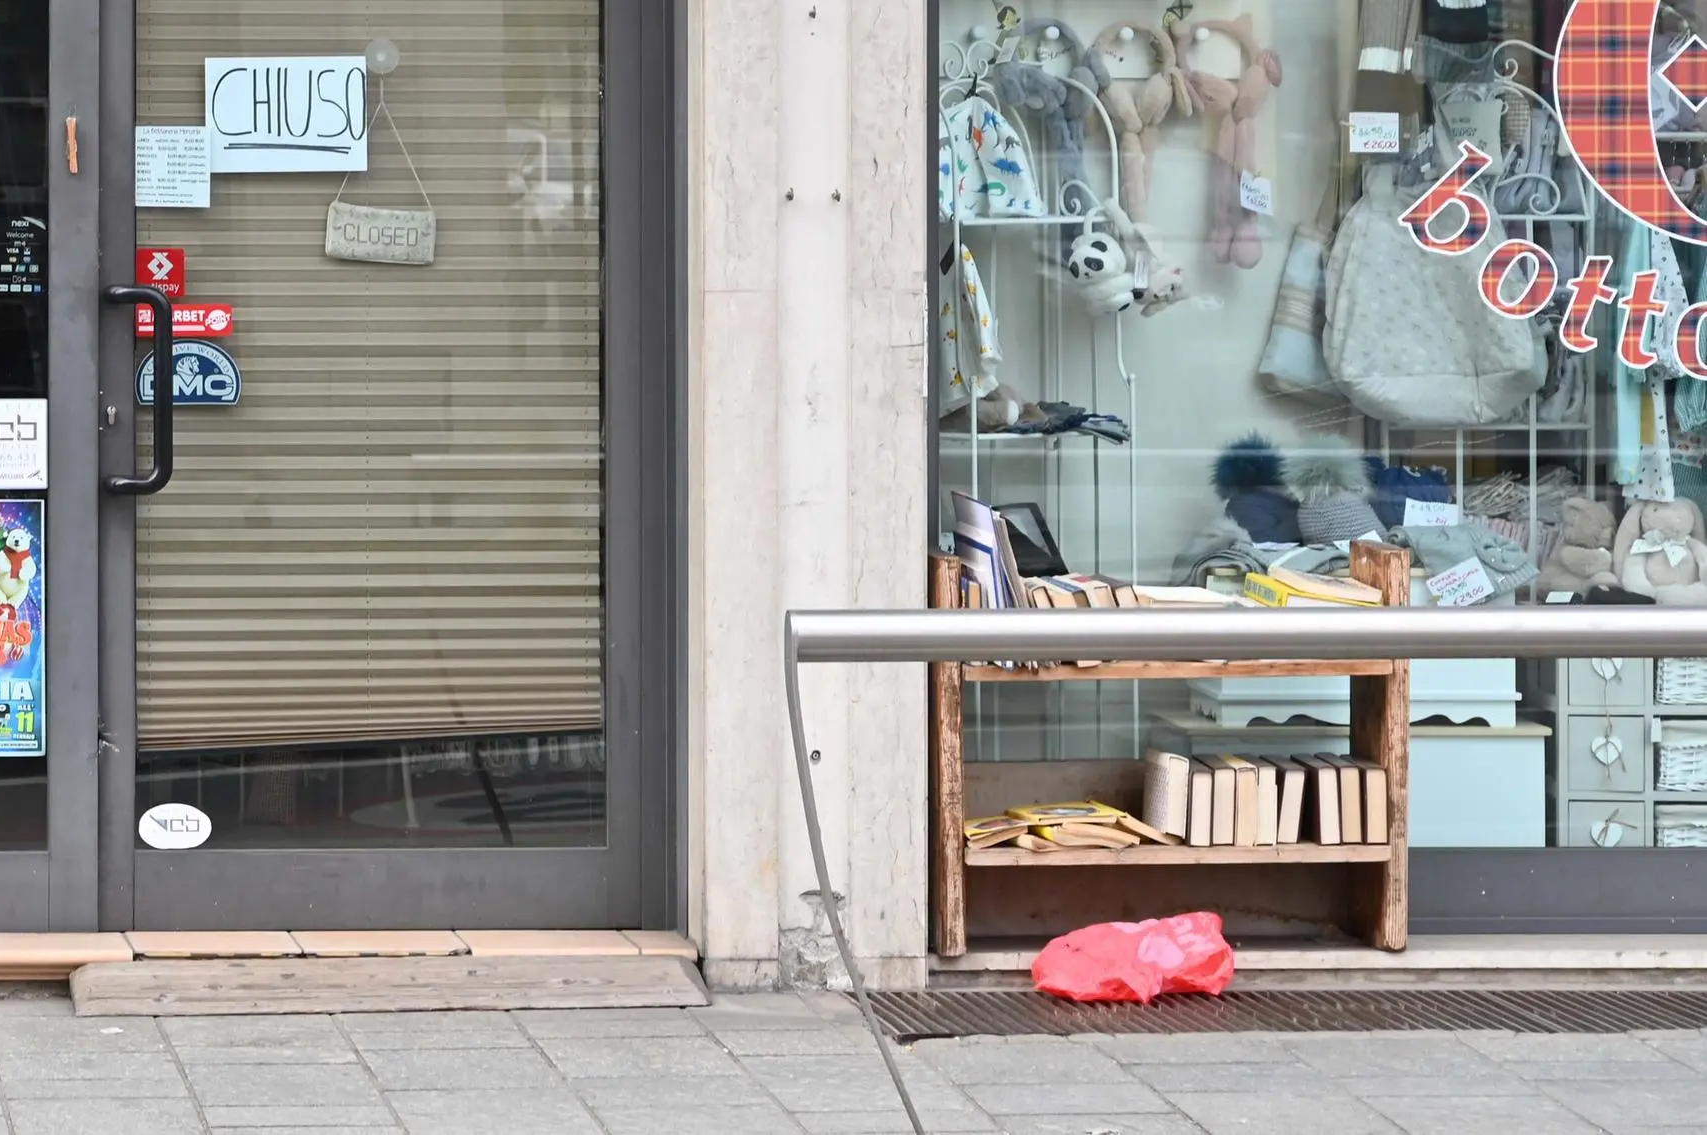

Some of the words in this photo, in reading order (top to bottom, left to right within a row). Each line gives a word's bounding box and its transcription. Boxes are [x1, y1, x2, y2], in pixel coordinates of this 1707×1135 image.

[212, 67, 367, 141] CHIUSO
[6, 231, 35, 239] Welcome
[342, 223, 420, 248] CLOSED
[15, 711, 35, 733] 11
